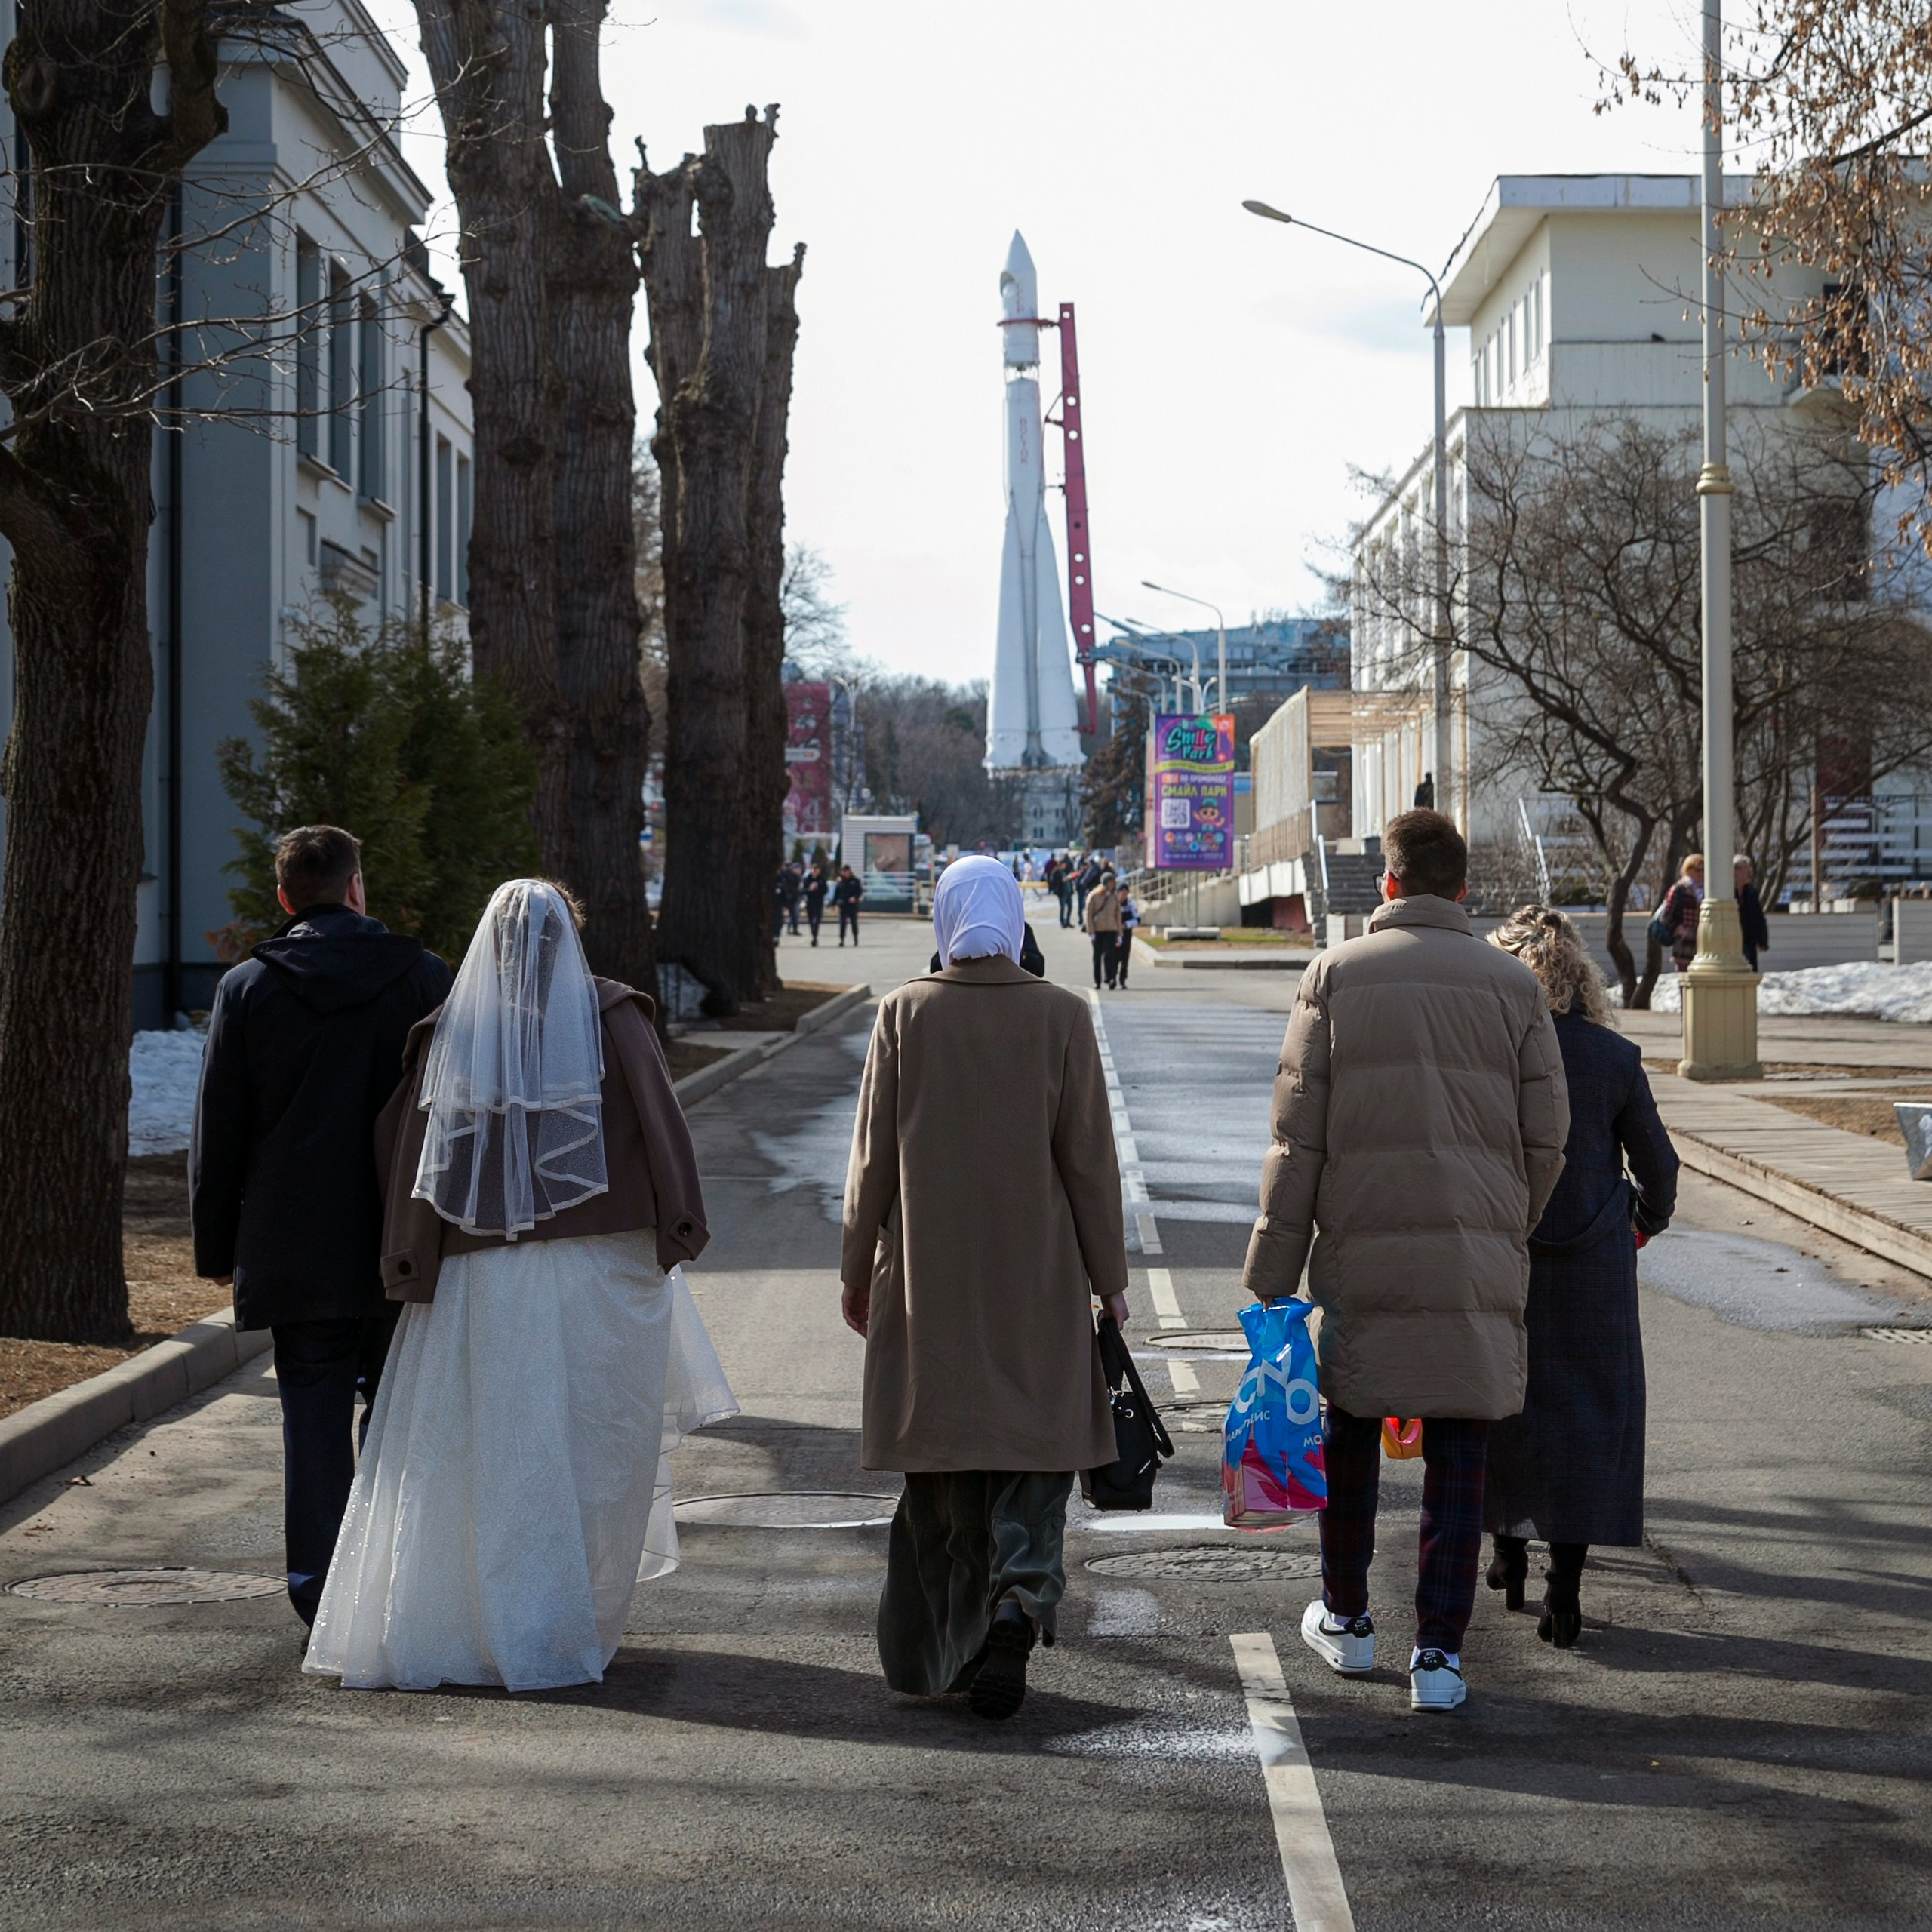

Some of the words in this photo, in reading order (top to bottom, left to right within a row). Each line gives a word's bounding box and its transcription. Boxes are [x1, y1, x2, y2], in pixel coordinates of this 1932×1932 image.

[1164, 726, 1217, 753] Smile
[1182, 744, 1215, 761] Park
[1161, 783, 1198, 796] СМАЙЛ
[1201, 785, 1227, 796] ПАРК
